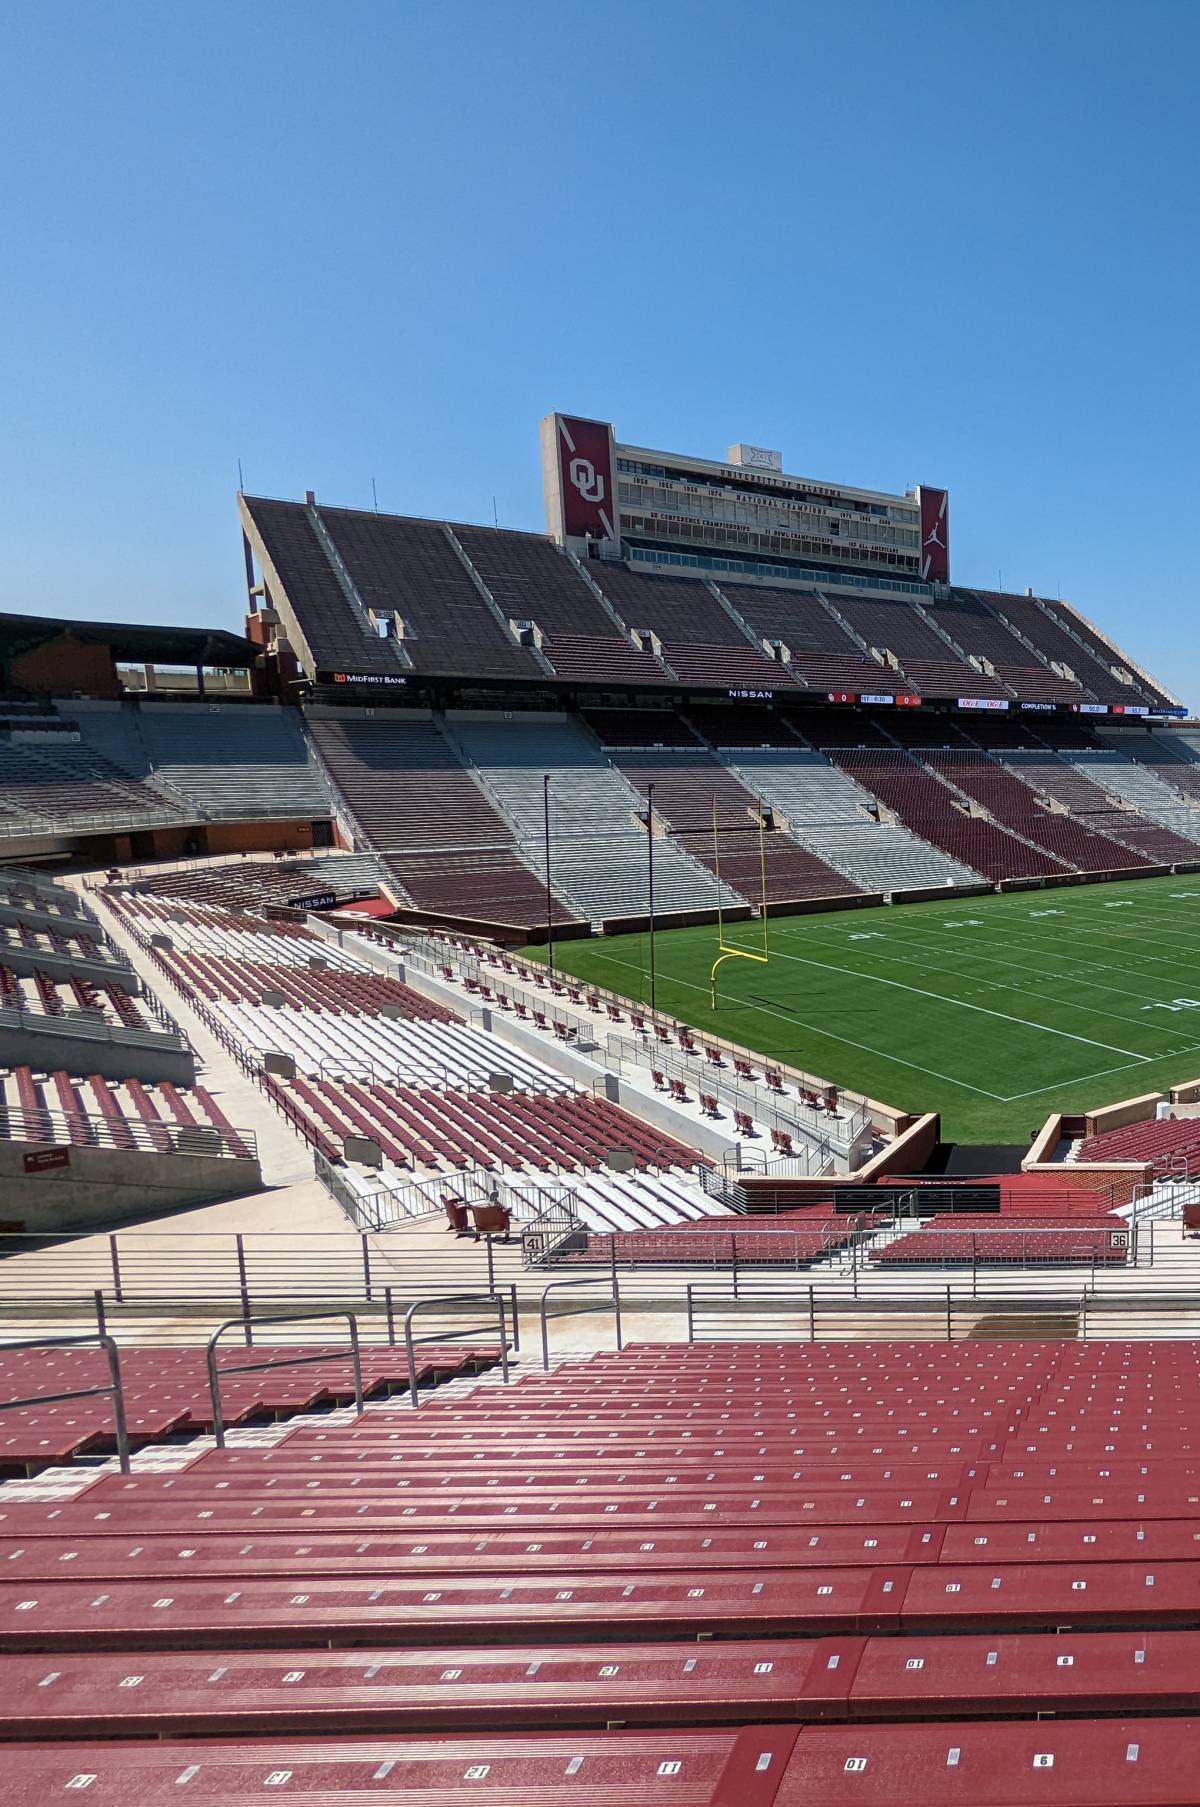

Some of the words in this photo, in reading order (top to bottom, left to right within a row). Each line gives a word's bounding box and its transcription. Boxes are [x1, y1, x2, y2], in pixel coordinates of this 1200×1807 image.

[569, 458, 605, 502] OU
[720, 469, 777, 486] UNIVERSITY
[796, 484, 841, 497] OKLAHOMA
[737, 494, 778, 507] NATIONAL
[782, 502, 827, 515] CHAMPIONS
[660, 514, 700, 525] CONFERENCE
[702, 520, 750, 532] CHAMPIONSHIPS
[774, 530, 790, 538] BOWL
[791, 533, 833, 544] CHAMPIONSHIPS
[859, 543, 898, 554] ALL-AMERICANS
[729, 690, 773, 698] NISSAN
[1021, 703, 1051, 711] COMPLETION
[294, 896, 334, 909] NISSAN
[526, 1238, 539, 1250] 41
[1113, 1235, 1126, 1246] 36
[757, 1663, 771, 1672] 11
[907, 1659, 921, 1668] 10
[266, 1772, 289, 1783] 13
[466, 1766, 488, 1778] 12
[661, 1763, 679, 1773] 11
[846, 1759, 864, 1769] 10
